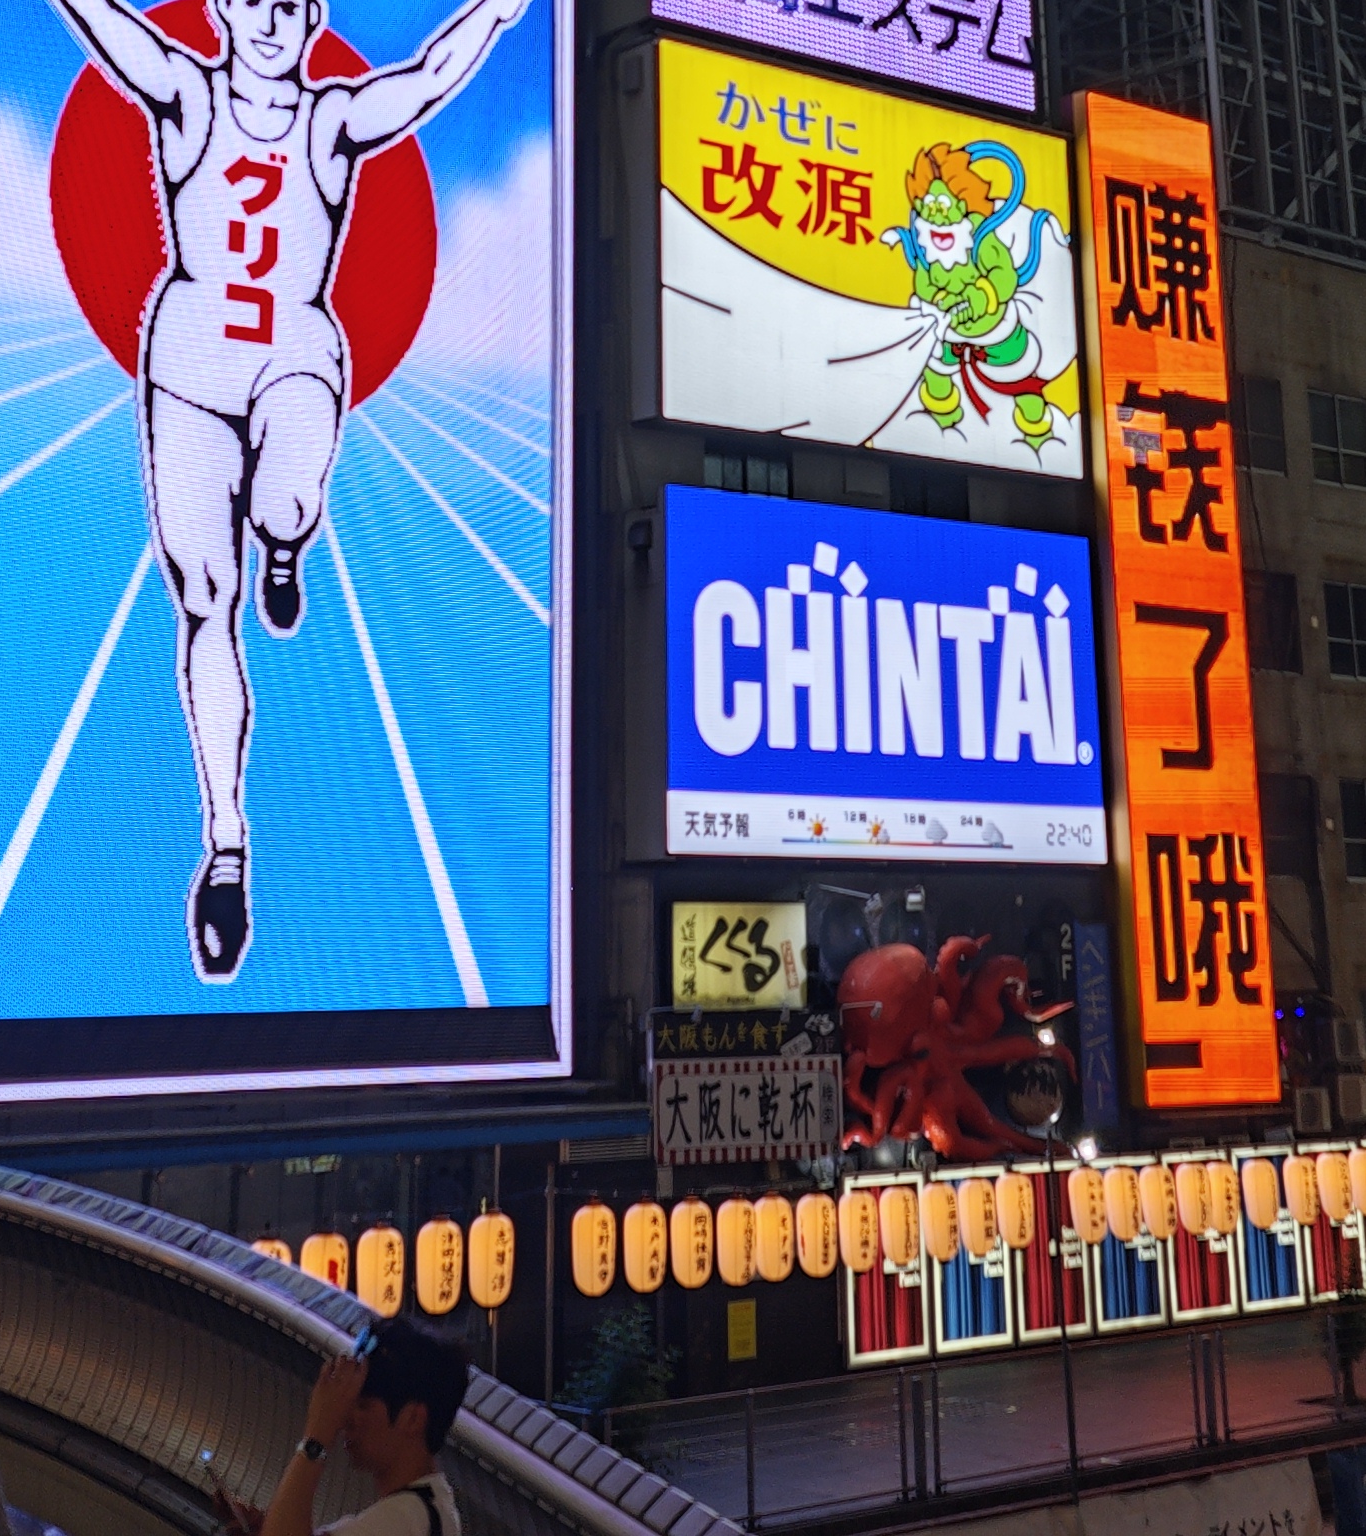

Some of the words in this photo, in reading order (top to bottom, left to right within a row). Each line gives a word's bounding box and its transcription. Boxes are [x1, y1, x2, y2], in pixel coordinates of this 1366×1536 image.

[717, 80, 860, 155] かぜに
[698, 137, 876, 247] 改源
[223, 154, 288, 346] グリコ
[684, 810, 750, 839] 天気予報
[1045, 822, 1094, 848] 22:40
[666, 1072, 816, 1145] 大阪に乾杯
